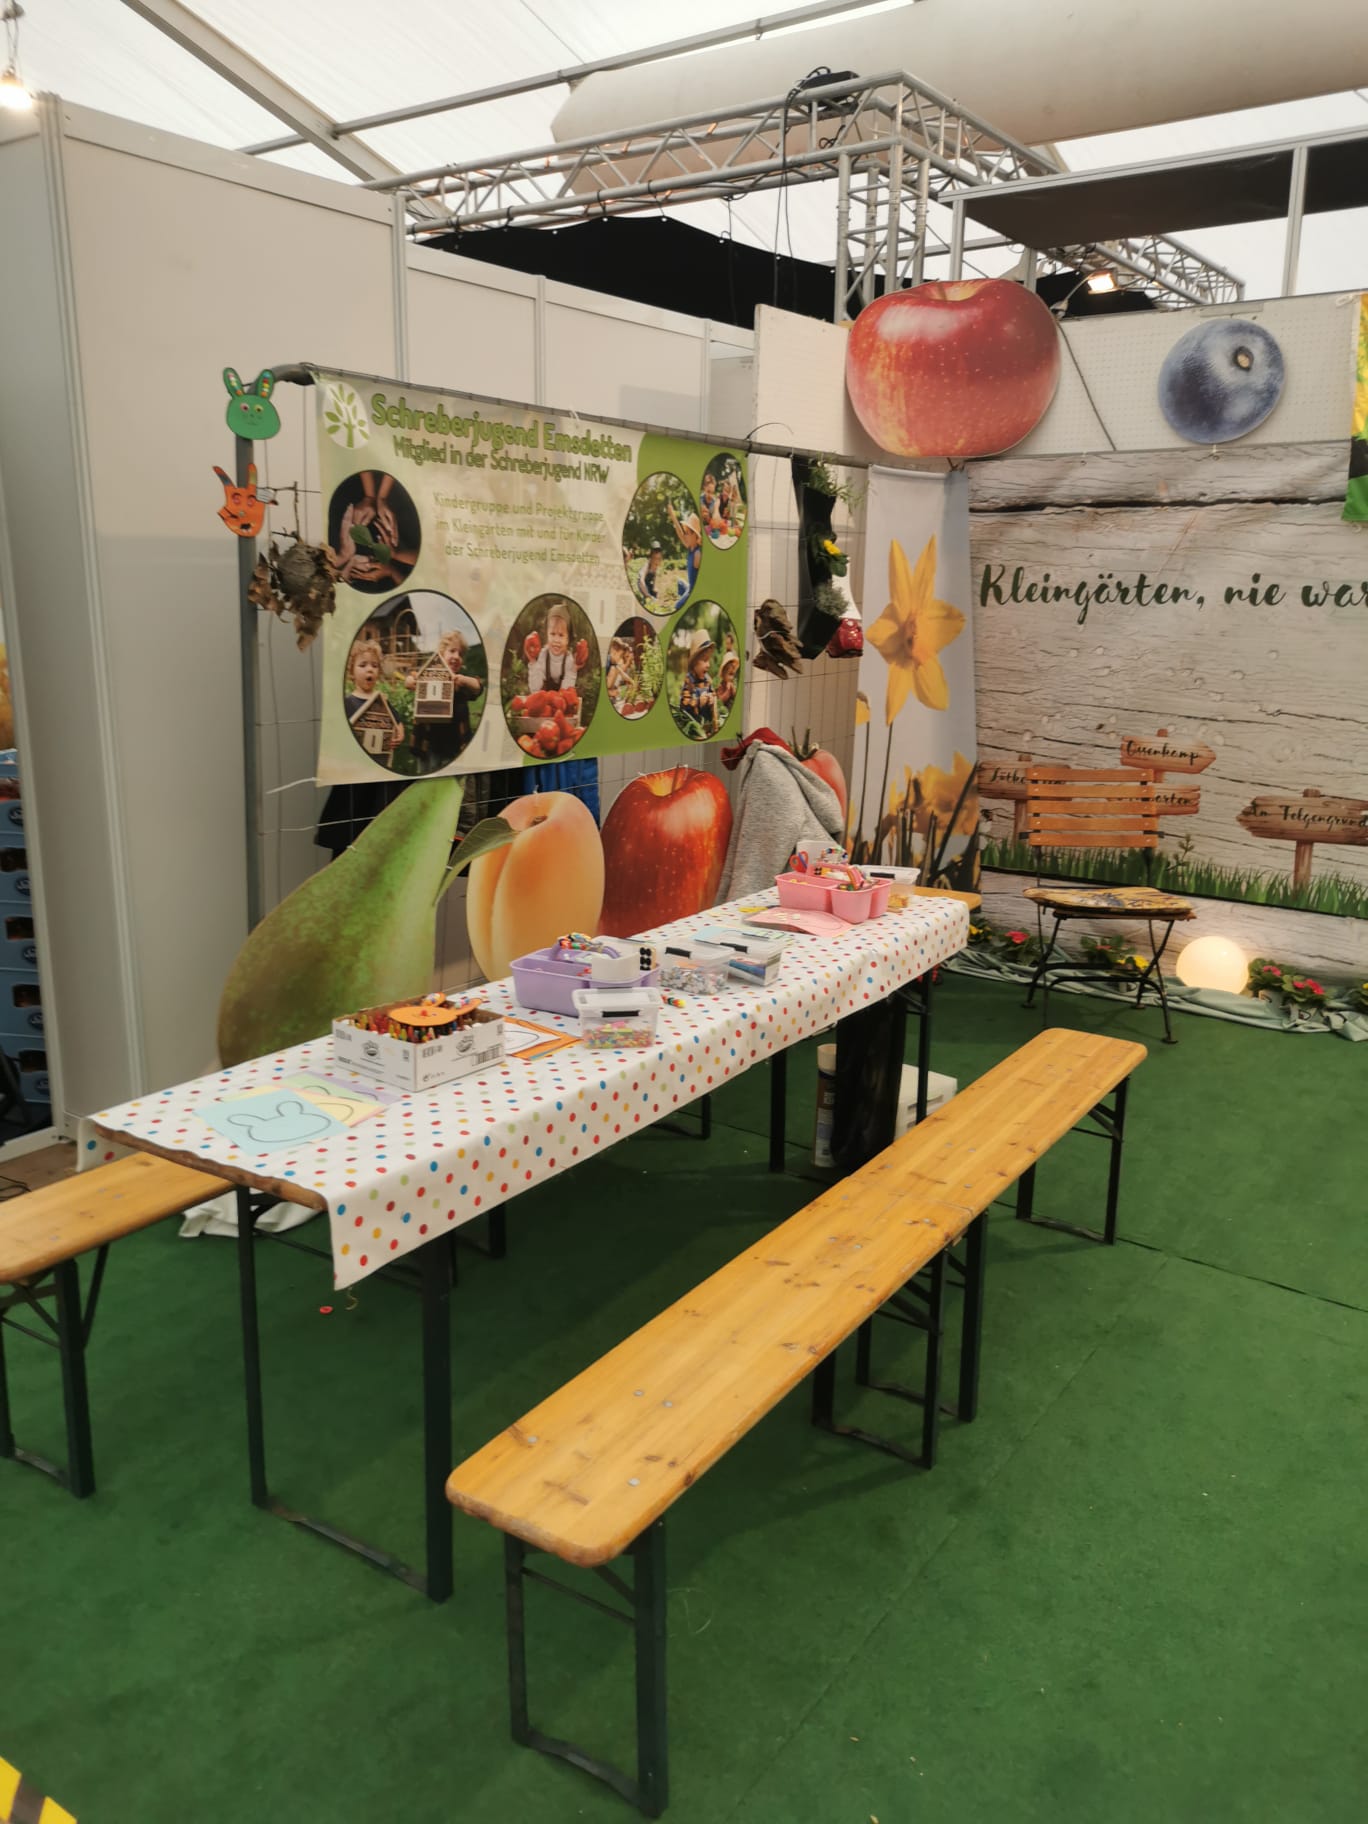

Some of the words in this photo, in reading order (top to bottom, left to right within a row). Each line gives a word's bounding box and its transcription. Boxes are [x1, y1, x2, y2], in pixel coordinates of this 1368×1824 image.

[372, 393, 539, 451] Schreberjugend
[543, 422, 632, 463] Emsdetten
[393, 435, 447, 466] Mitglied
[450, 444, 462, 465] in
[466, 446, 488, 468] der
[490, 449, 582, 482] Schreberjugend
[584, 463, 610, 484] NRW
[433, 491, 509, 516] Kindergruppe
[512, 500, 533, 515] und
[536, 502, 604, 524] Projektgruppe
[516, 523, 533, 538] mit
[536, 526, 556, 540] und
[445, 540, 463, 556] der
[467, 542, 547, 564] Schreberjugend
[551, 548, 600, 565] Emsdetten
[980, 563, 1204, 624] Kleingärten,
[1224, 573, 1286, 607] nie
